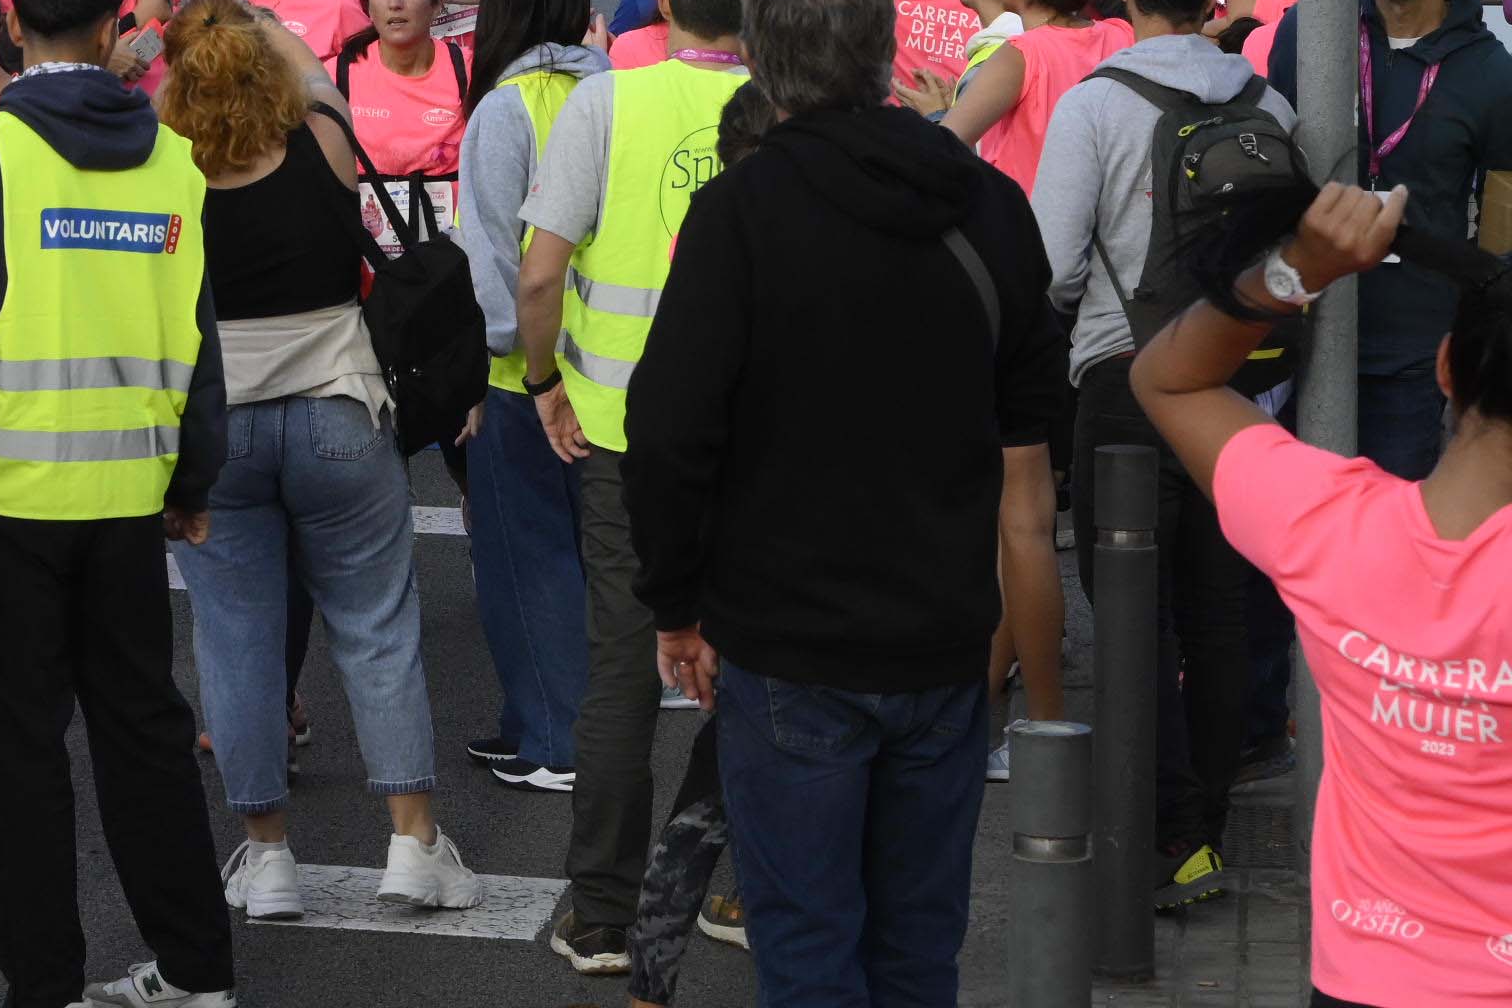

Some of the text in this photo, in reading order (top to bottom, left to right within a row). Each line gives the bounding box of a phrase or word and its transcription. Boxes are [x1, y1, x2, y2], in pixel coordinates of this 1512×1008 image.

[898, 0, 983, 31] CARRERA
[911, 19, 964, 44] DE LA
[905, 34, 965, 60] MUJER
[672, 149, 714, 191] Sp
[44, 219, 166, 243] VOLUNTARIS
[1370, 693, 1503, 744] MUJER
[1420, 739, 1456, 756] 2023
[1331, 899, 1425, 940] OYSHO
